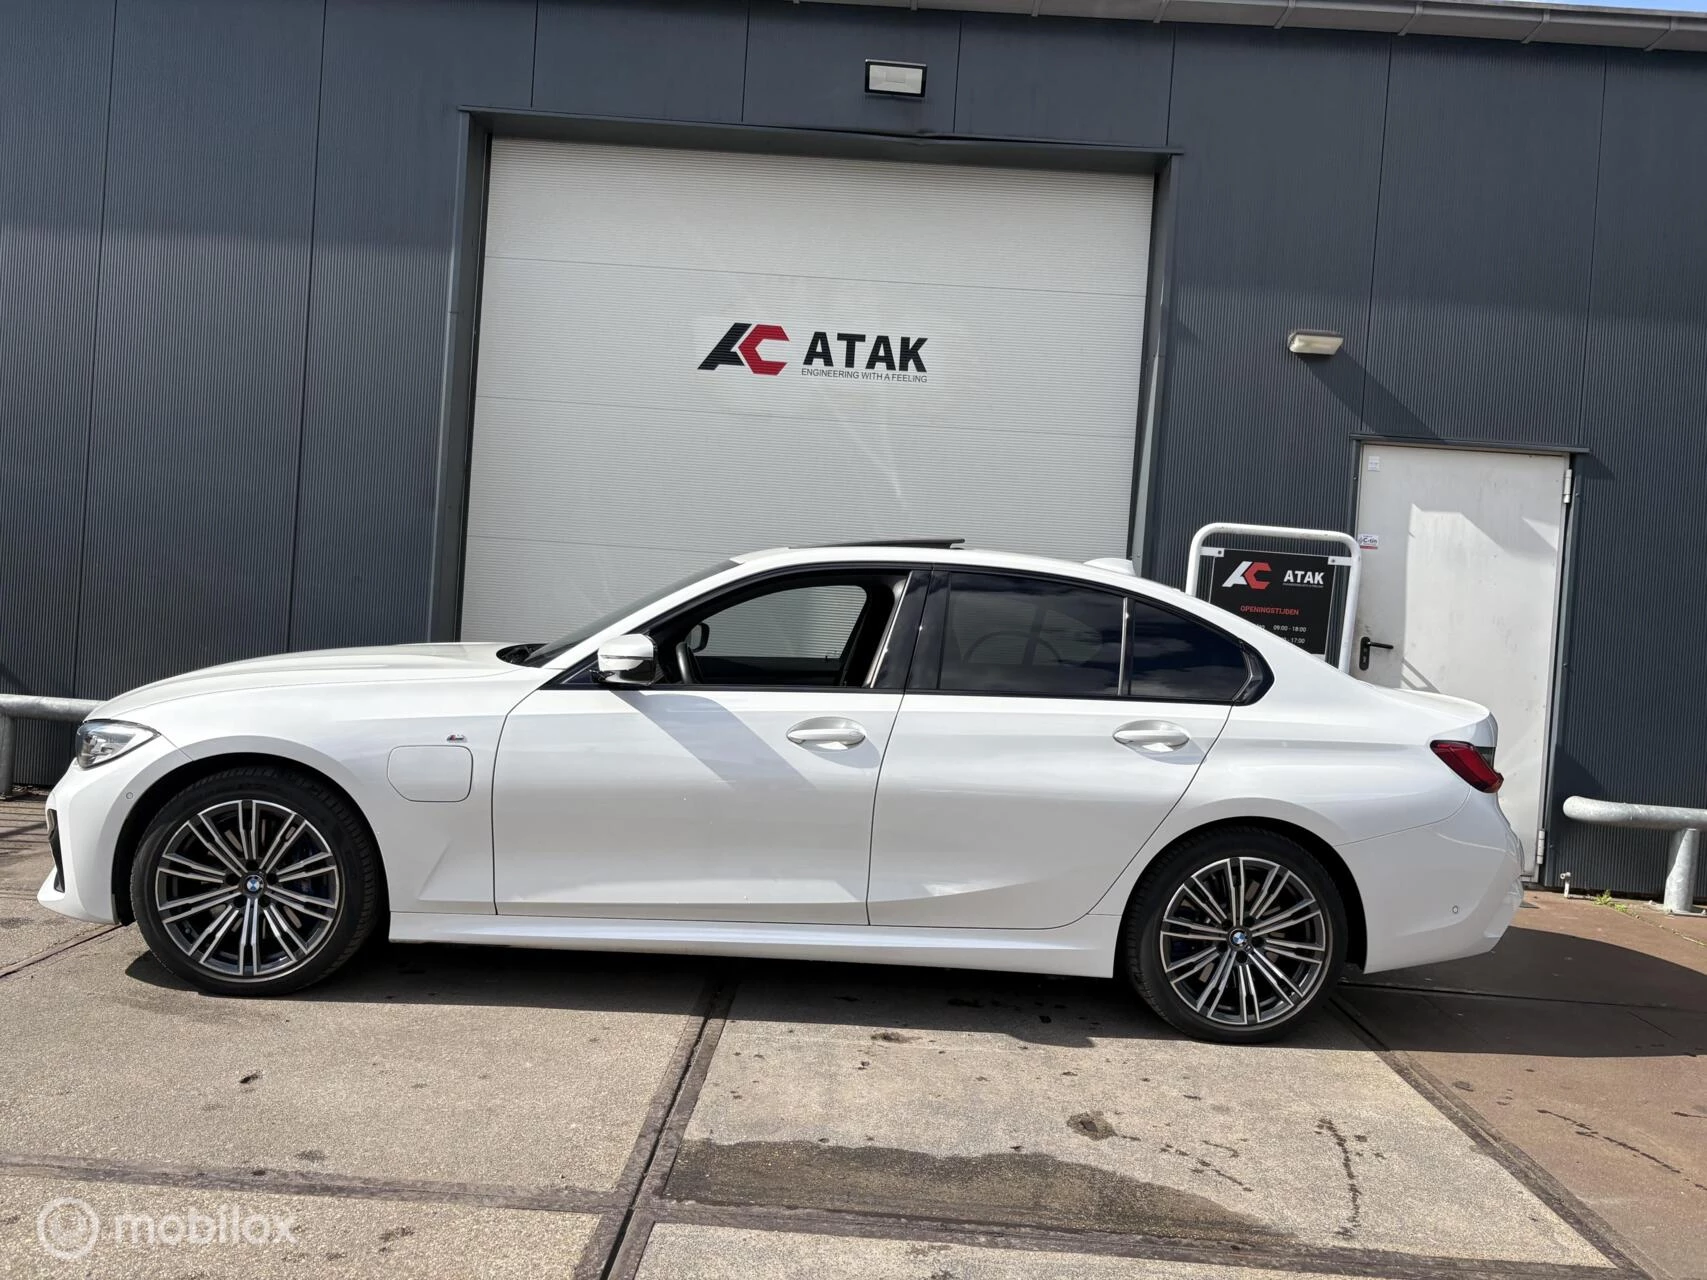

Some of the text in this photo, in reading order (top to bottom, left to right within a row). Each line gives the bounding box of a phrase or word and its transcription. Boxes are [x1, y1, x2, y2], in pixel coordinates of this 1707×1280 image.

[802, 331, 928, 373] ATAK
[801, 368, 860, 379] ENGINEERING
[861, 371, 883, 381] WITH
[891, 373, 928, 383] FEELING
[1283, 569, 1325, 585] ATAK
[1240, 605, 1300, 616] OPENINGSTIJDEN
